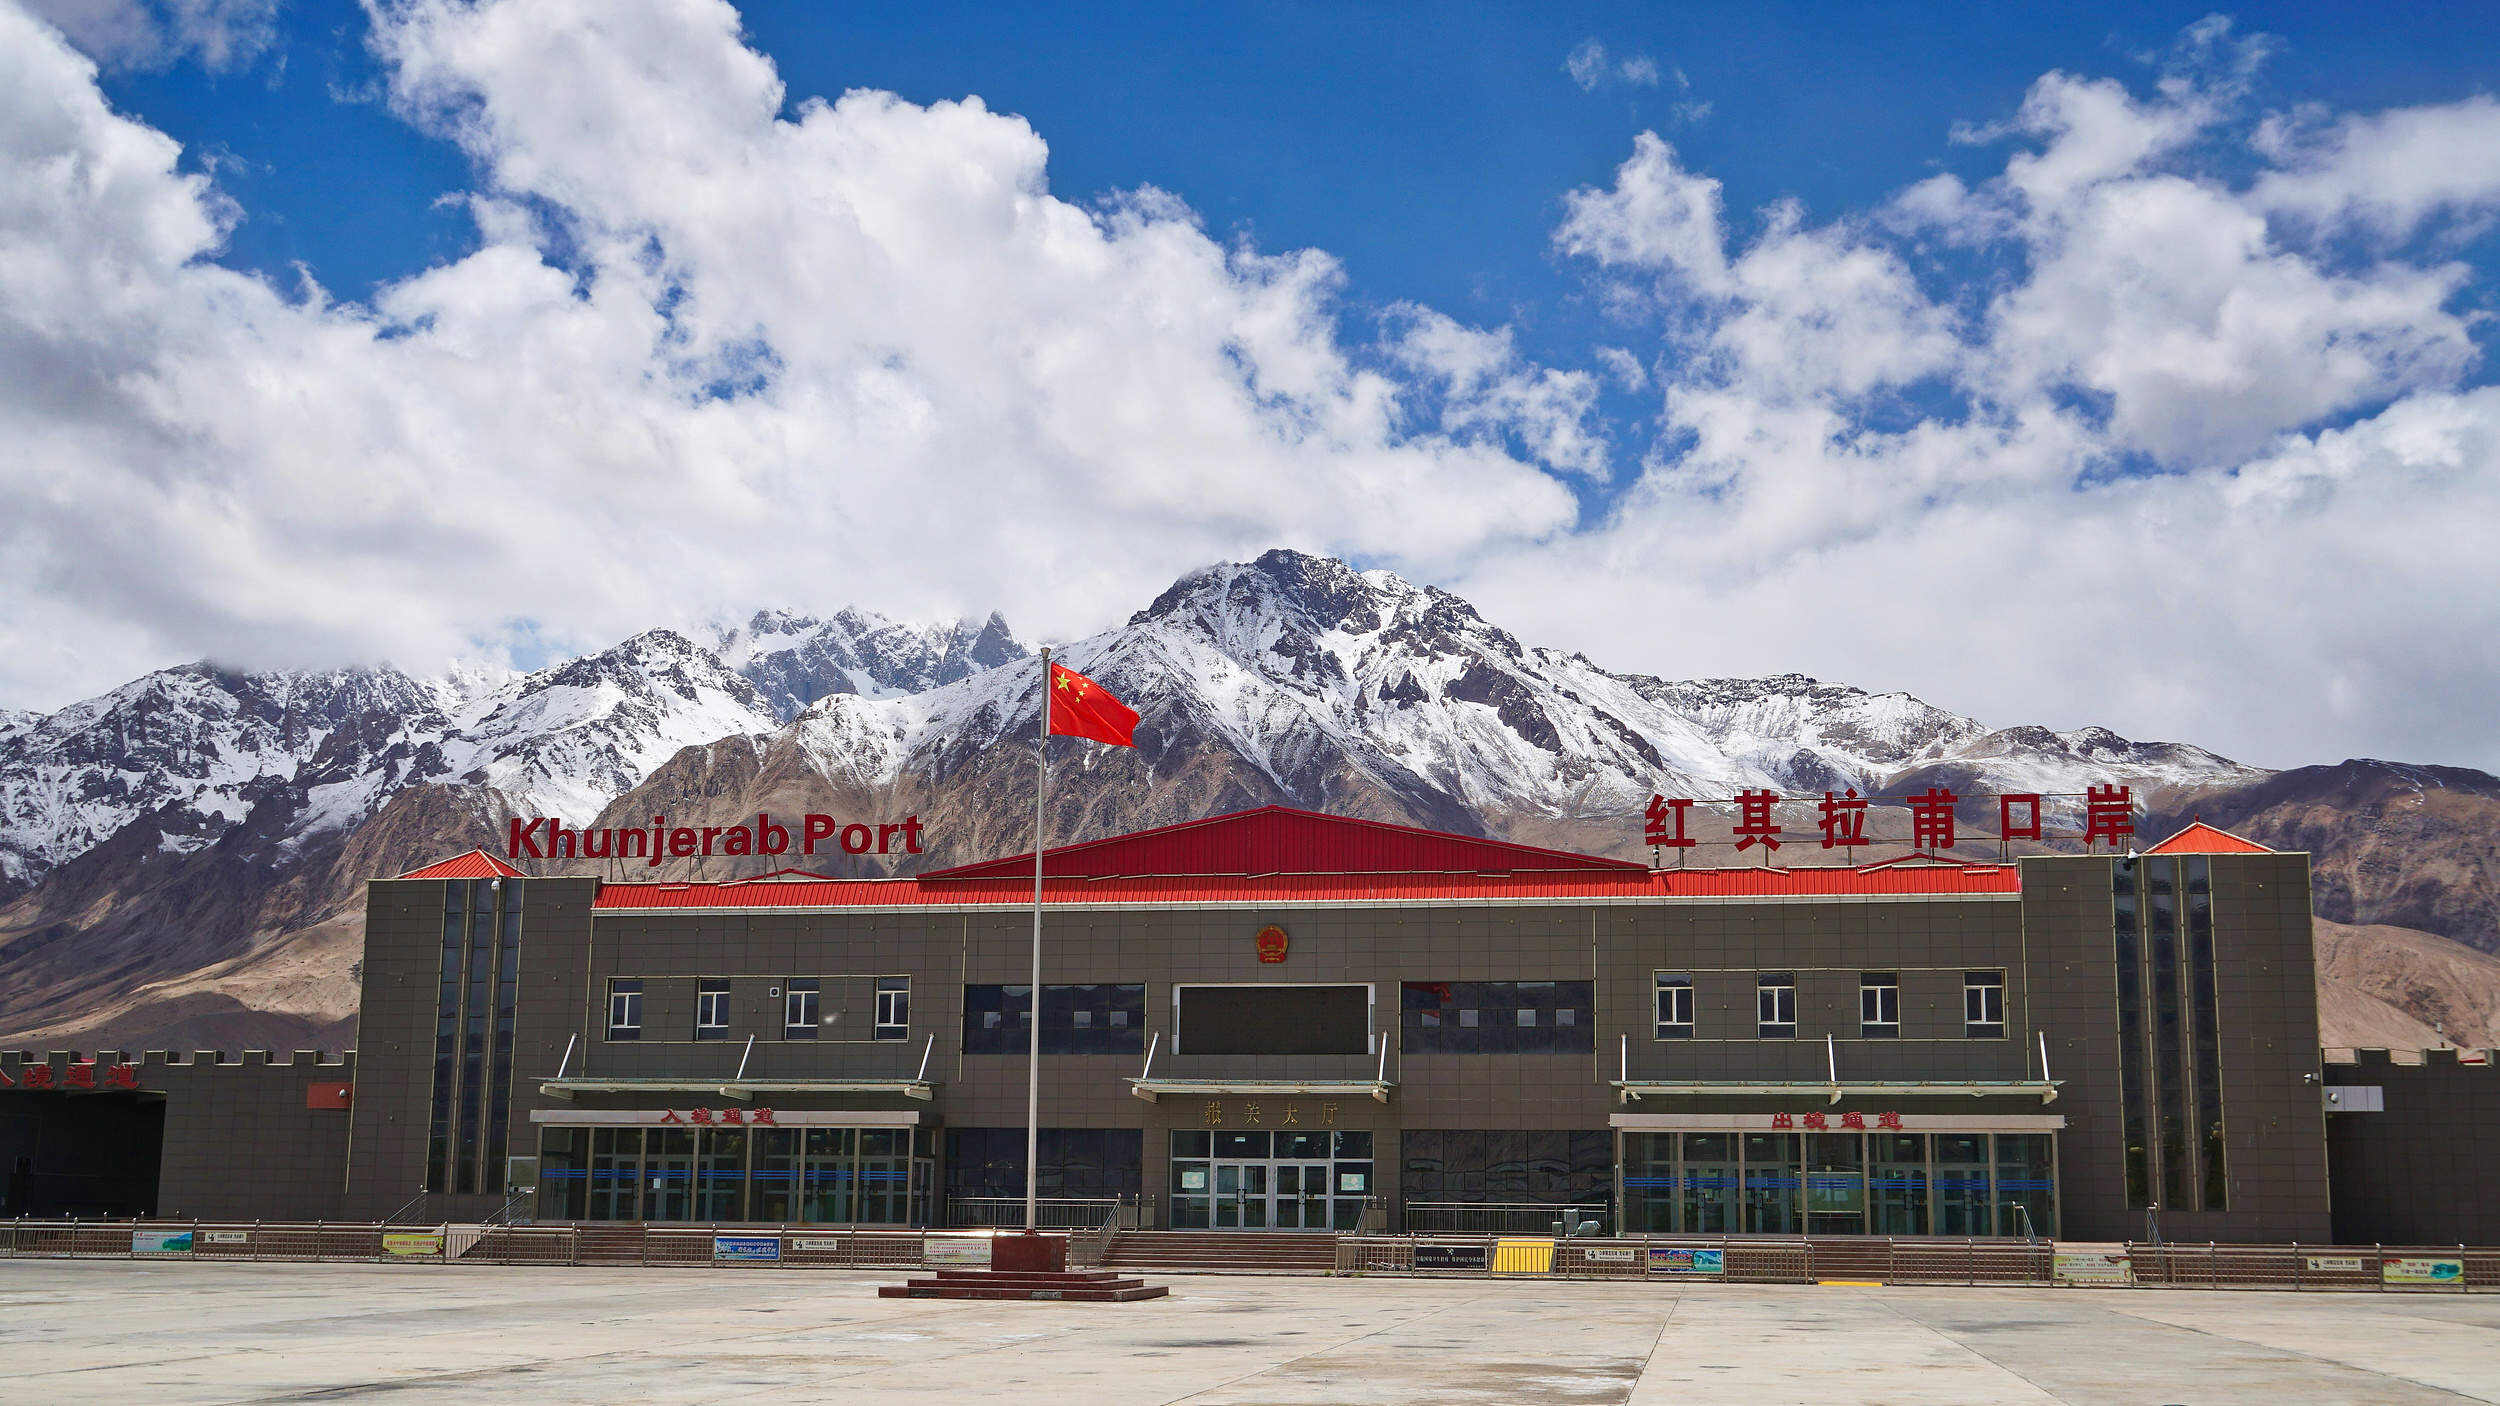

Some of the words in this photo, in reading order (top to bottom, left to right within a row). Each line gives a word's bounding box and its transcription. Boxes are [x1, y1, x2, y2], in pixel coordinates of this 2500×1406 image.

[1644, 783, 2135, 850] 红其拉甫口岸
[508, 814, 790, 867] Khunjerab
[803, 814, 925, 856] Port
[660, 1107, 777, 1126] 入境通道
[1771, 1111, 1904, 1131] 出境通道
